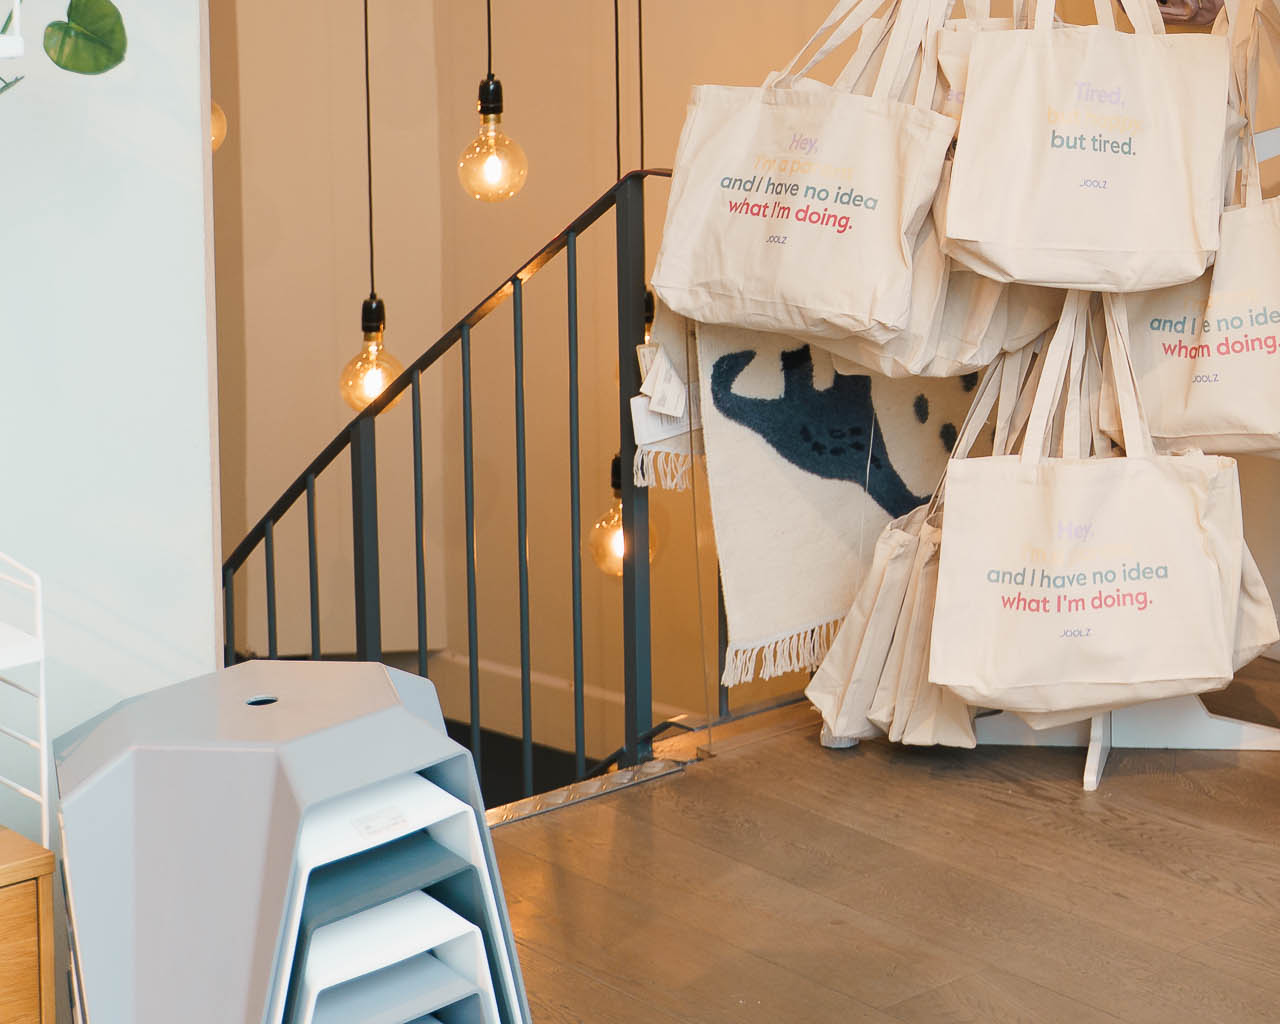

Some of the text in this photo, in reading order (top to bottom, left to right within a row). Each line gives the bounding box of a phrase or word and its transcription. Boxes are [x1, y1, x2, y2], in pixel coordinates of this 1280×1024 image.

[788, 133, 818, 155] Hey,
[1051, 129, 1136, 156] but tired.
[720, 175, 756, 193] and
[764, 177, 799, 196] have
[803, 184, 829, 202] no
[834, 186, 878, 211] idea
[1079, 177, 1108, 189] JOOLZ
[728, 197, 853, 234] what I'm doing.
[1150, 316, 1187, 335] and
[1216, 314, 1244, 332] no
[987, 561, 1169, 589] and I have no idea
[1000, 587, 1154, 613] what I'm doing.
